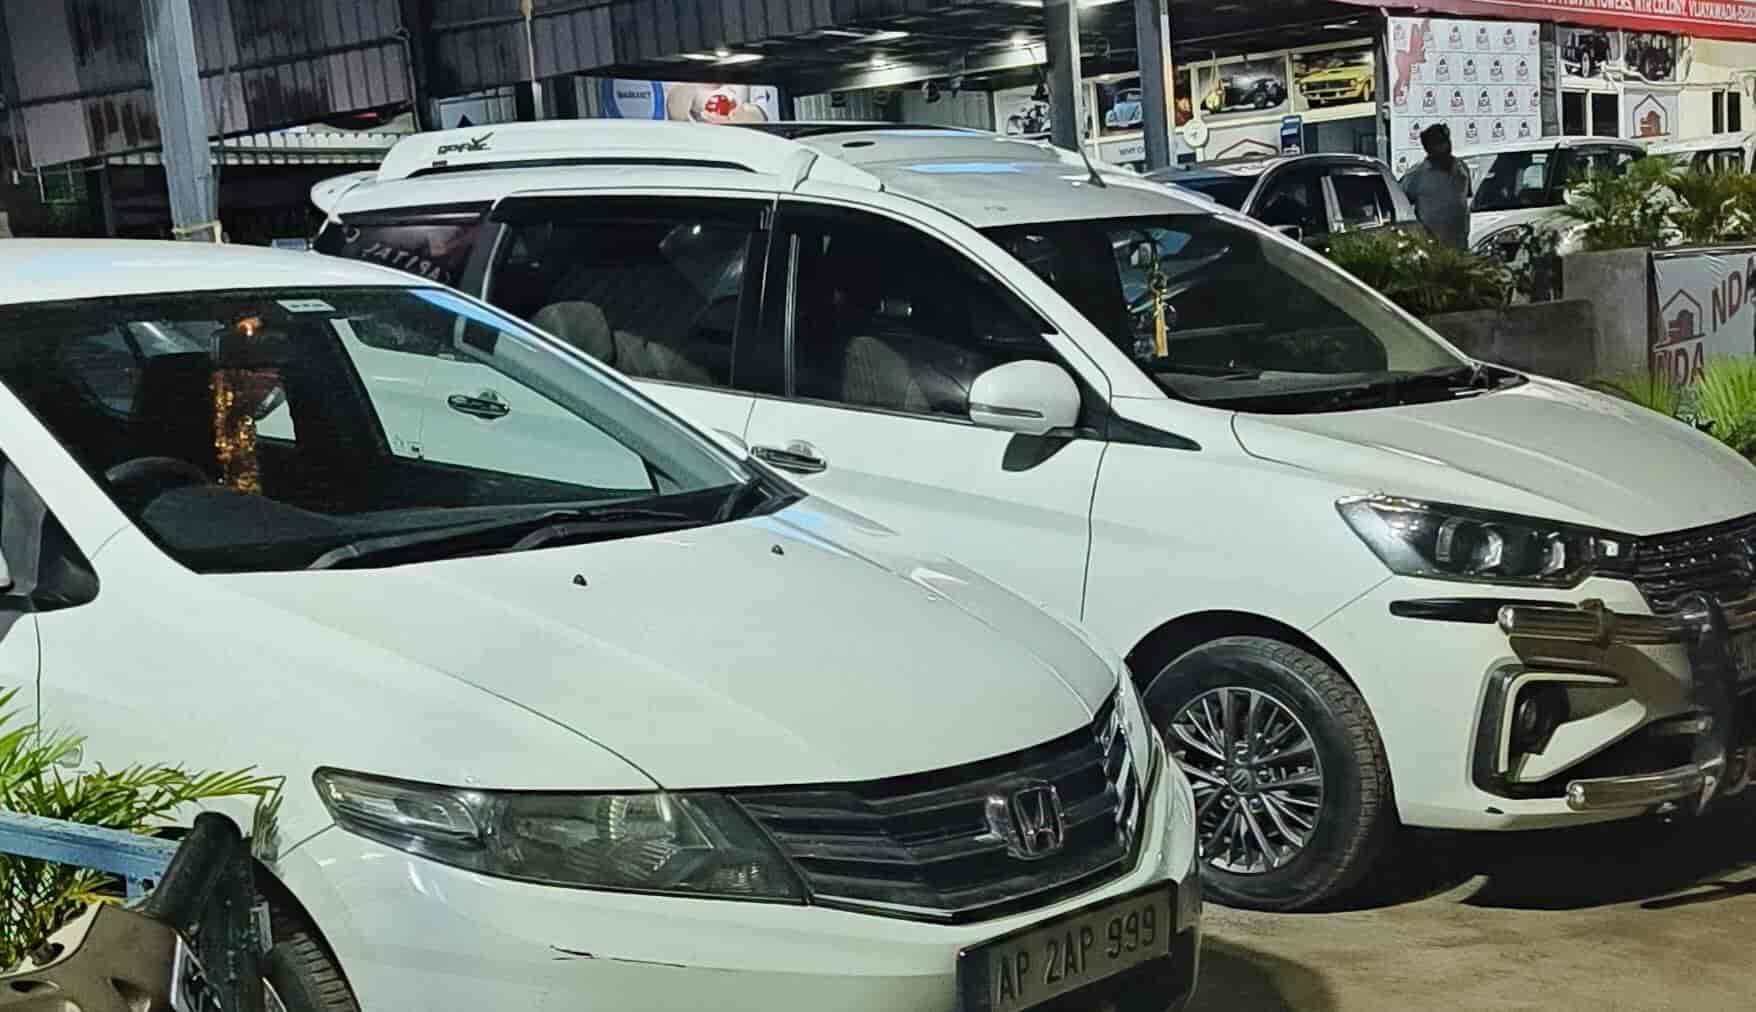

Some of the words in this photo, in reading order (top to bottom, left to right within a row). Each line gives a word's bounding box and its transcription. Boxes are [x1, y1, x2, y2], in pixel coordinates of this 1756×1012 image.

[997, 950, 1030, 1003] AP
[1046, 925, 1095, 985] 2AP
[1106, 903, 1158, 959] 999
